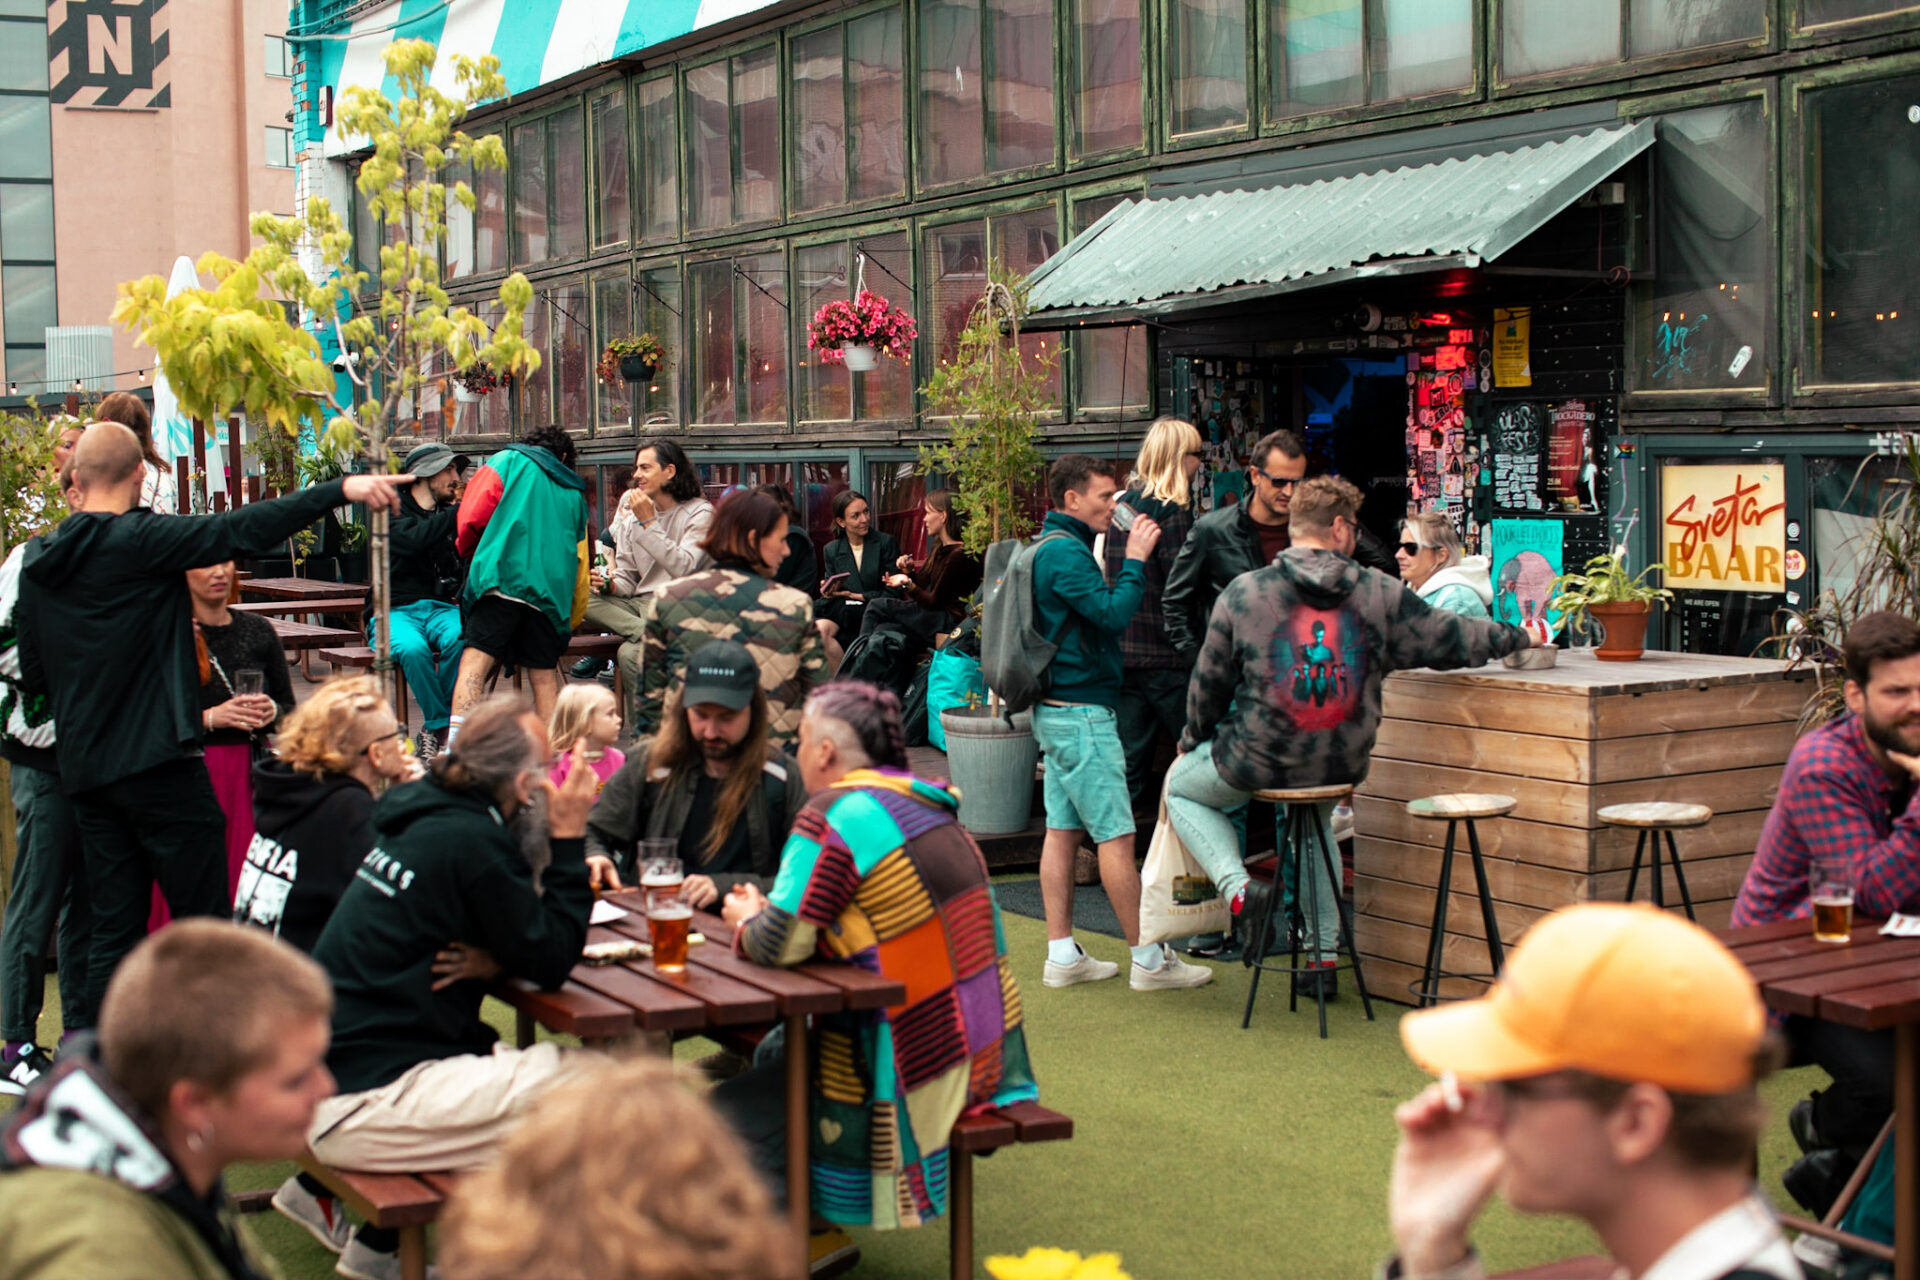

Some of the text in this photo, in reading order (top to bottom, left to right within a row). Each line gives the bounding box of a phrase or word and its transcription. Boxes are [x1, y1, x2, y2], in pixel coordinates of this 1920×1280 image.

[86, 13, 133, 76] N
[1665, 474, 1786, 562] Sveta
[1668, 541, 1782, 584] BAAR
[1684, 598, 1720, 608] WE ARE OPEN
